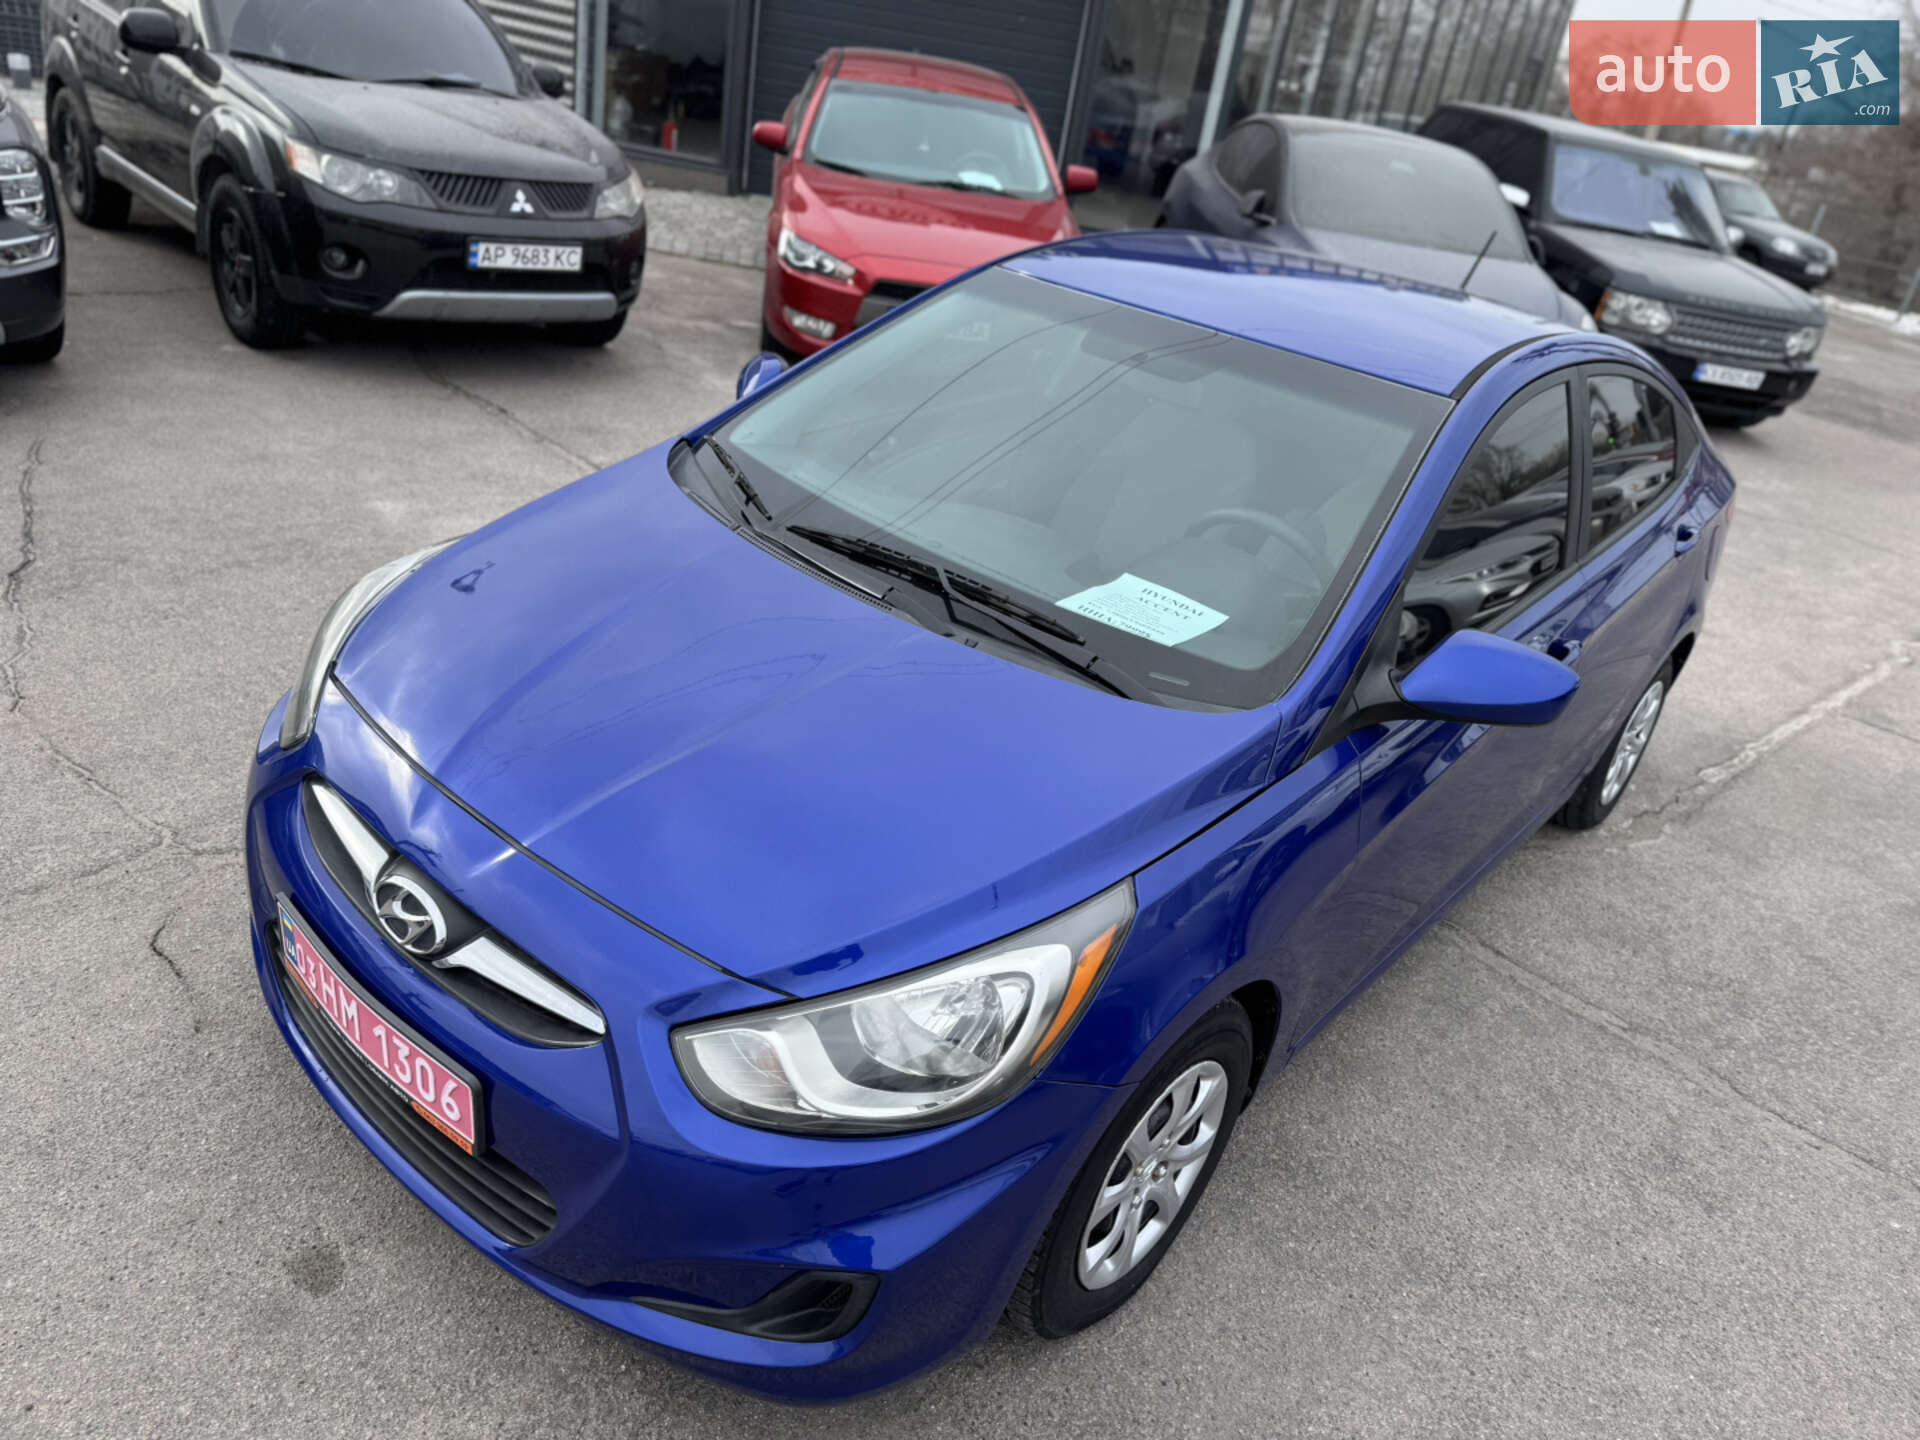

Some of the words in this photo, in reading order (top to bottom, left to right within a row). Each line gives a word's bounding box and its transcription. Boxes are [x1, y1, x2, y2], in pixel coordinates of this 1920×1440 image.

[481, 246, 506, 264] AP
[511, 247, 550, 266] 9683
[554, 250, 579, 267] KC
[1138, 597, 1191, 620] ACCENT
[1141, 587, 1205, 617] HYUNDAI
[373, 1024, 461, 1121] 1306
